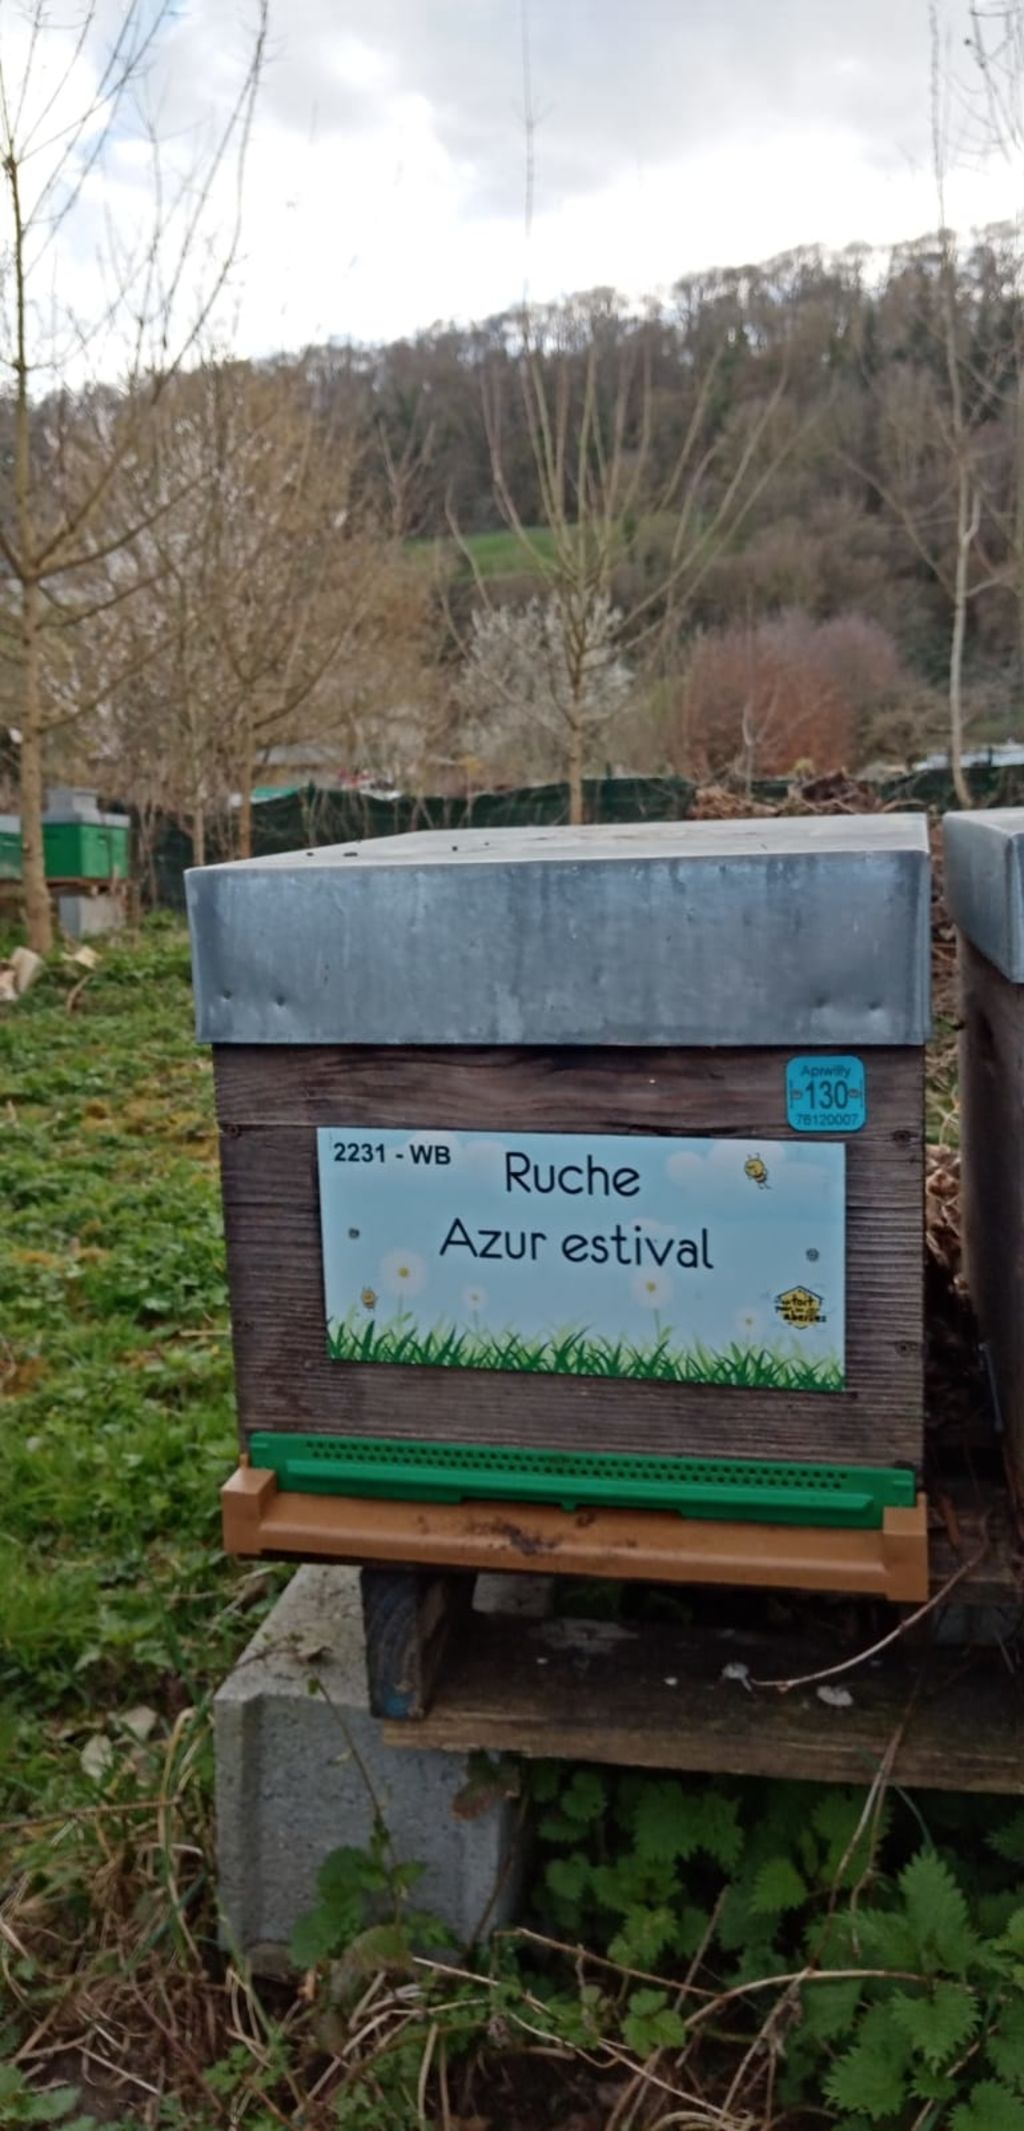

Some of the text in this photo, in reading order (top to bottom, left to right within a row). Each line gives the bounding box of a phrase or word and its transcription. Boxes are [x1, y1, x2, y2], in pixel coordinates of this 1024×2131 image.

[805, 1080, 848, 1109] 130
[333, 1142, 385, 1163] 2231
[409, 1144, 451, 1165] WB
[505, 1151, 640, 1197] Ruche
[439, 1217, 714, 1269] Azur estival
